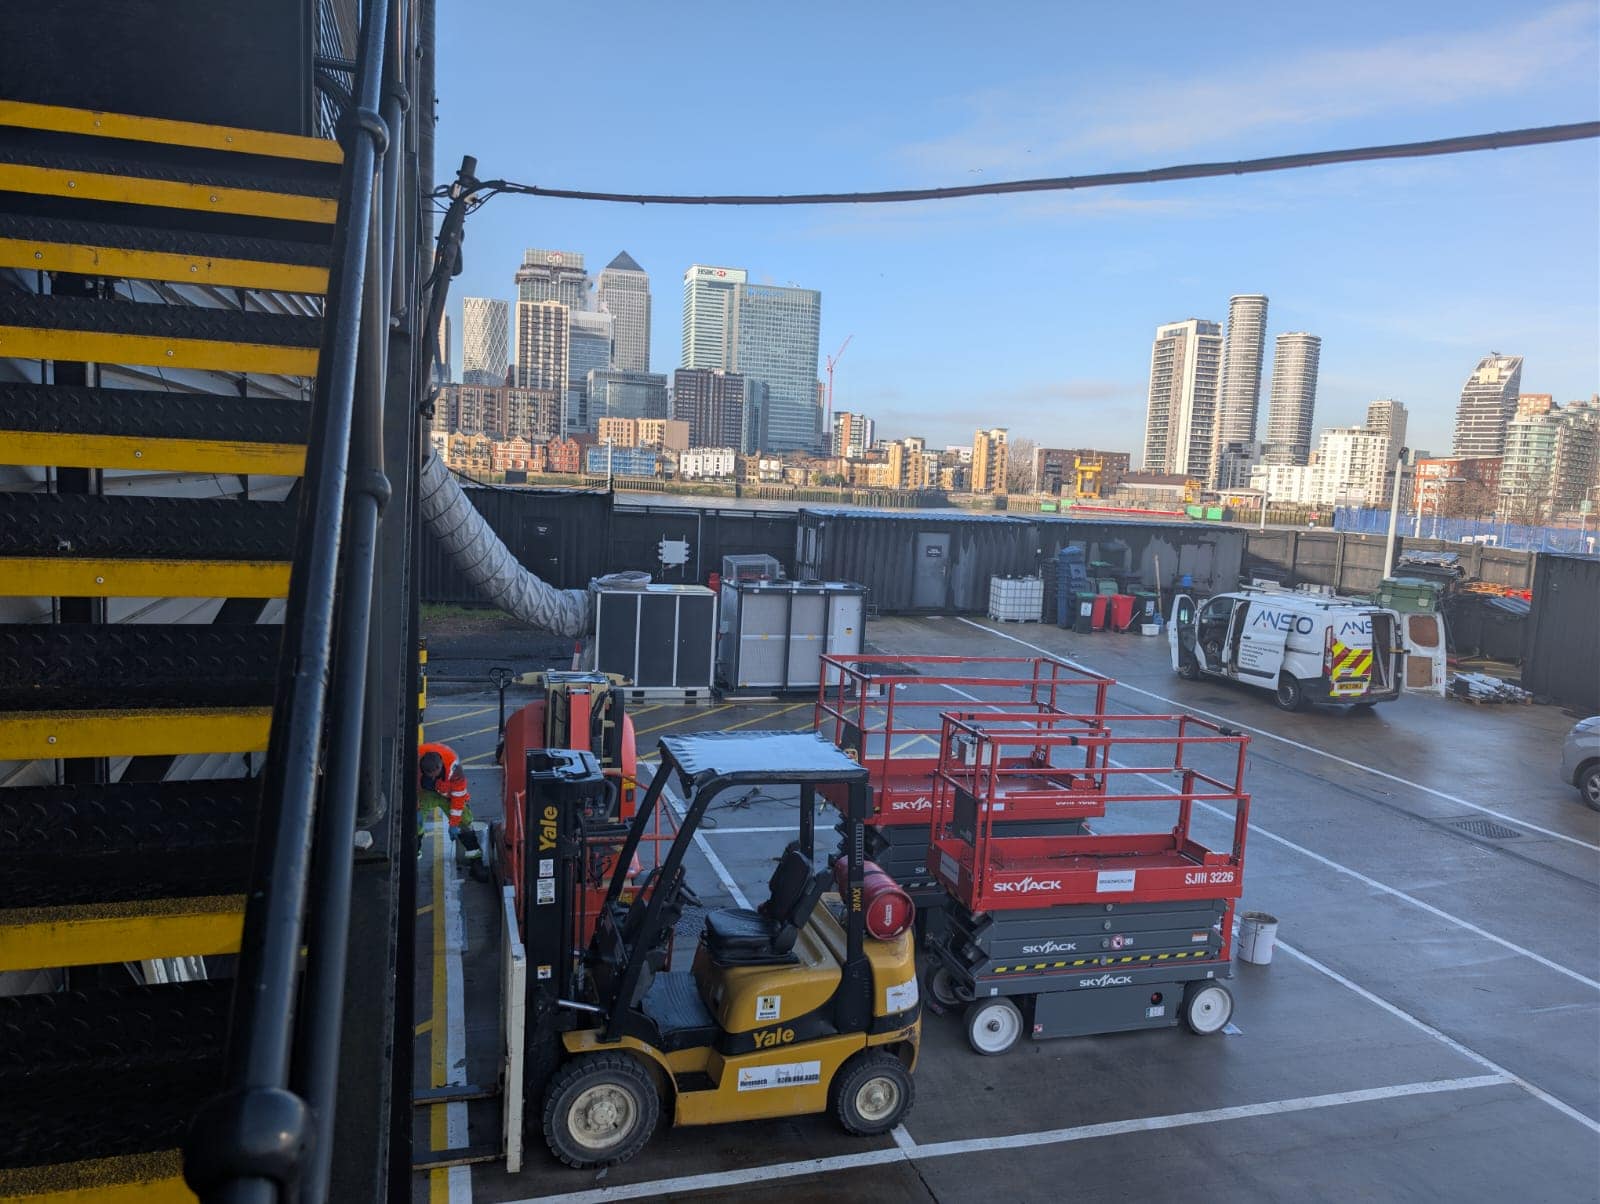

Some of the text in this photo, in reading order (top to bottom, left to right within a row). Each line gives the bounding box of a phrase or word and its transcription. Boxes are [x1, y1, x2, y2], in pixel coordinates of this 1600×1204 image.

[1253, 610, 1314, 635] ANSO
[538, 805, 559, 852] Yale
[993, 875, 1062, 893] SKYJACK
[1209, 871, 1234, 884] 3226
[1022, 940, 1077, 954] SKYJACK
[1079, 974, 1132, 988] SKYJACK
[752, 1027, 795, 1048] Yale
